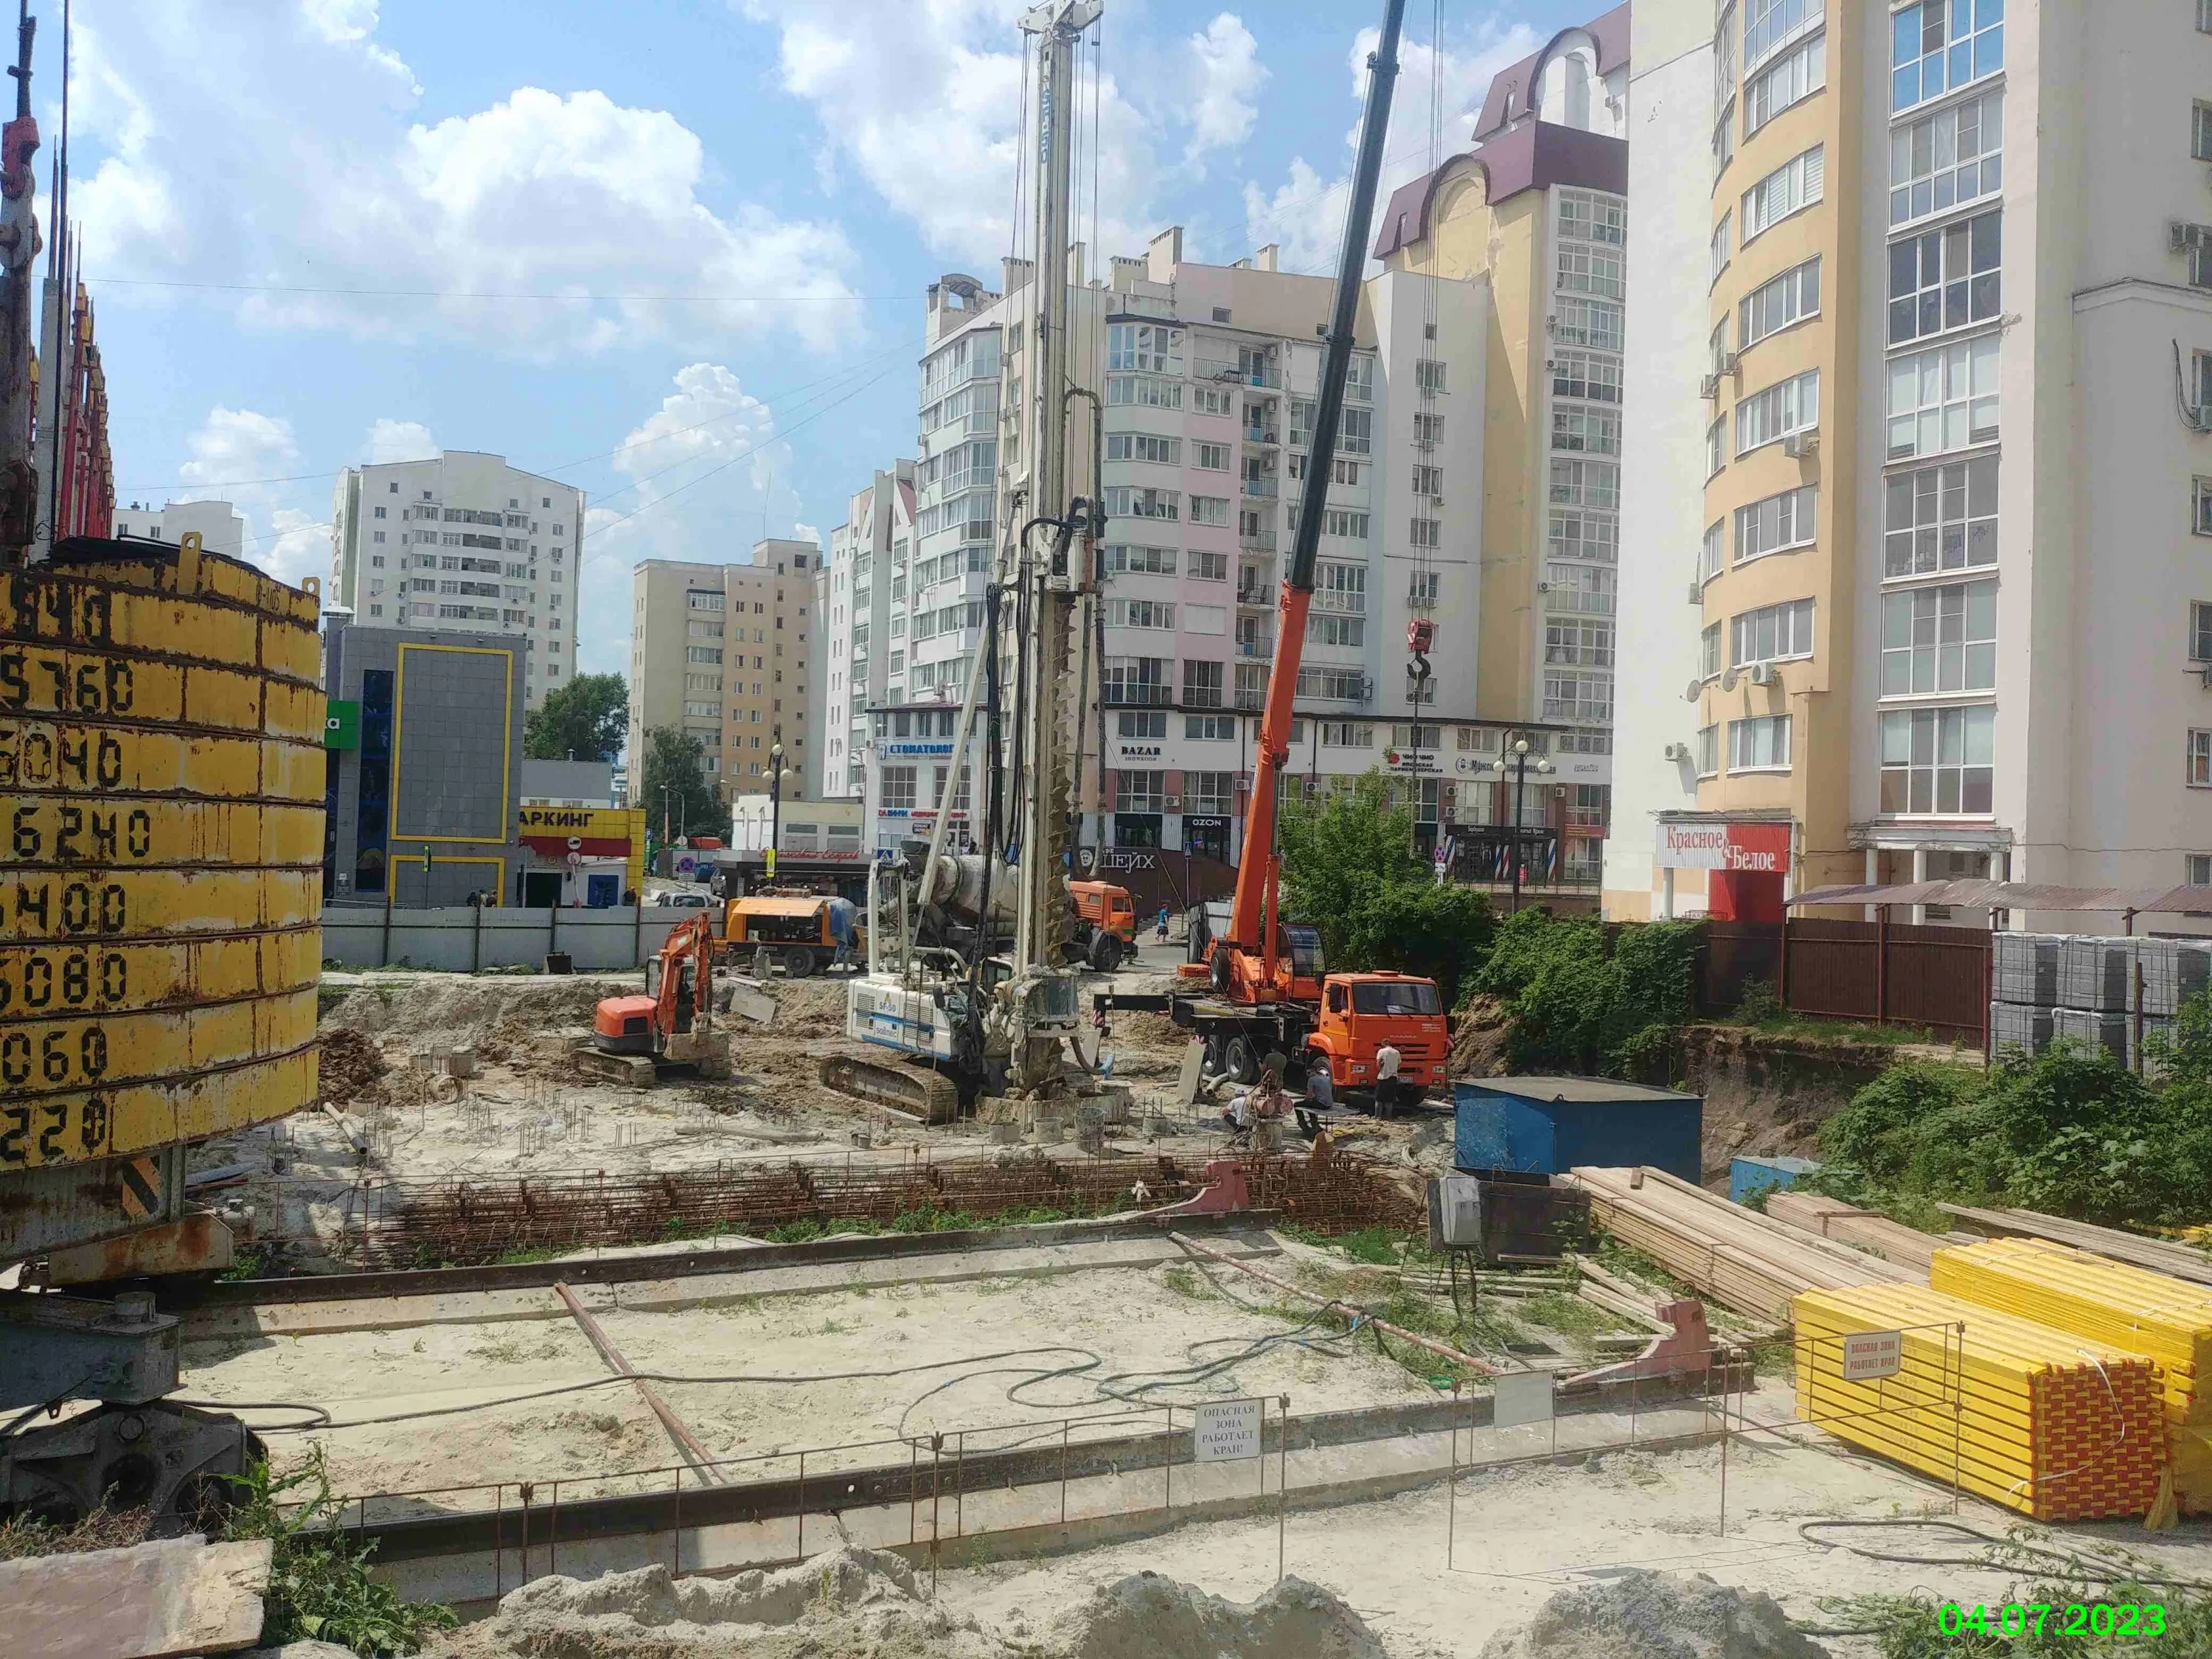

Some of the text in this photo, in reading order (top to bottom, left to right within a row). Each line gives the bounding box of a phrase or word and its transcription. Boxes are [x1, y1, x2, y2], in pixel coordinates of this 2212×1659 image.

[1, 654, 133, 714] 5760
[890, 743, 956, 754] СТОМАТОЛОГ
[1121, 746, 1161, 756] BAZAR
[519, 811, 594, 827] АРКИНГ
[1192, 818, 1222, 827] OZON
[13, 807, 150, 858] 6240
[1666, 826, 1723, 855] Красное
[1728, 845, 1775, 870] Белое
[0, 883, 125, 932] 400
[3, 1027, 107, 1083] 060
[1203, 1405, 1255, 1417] ОПАСНАЯ
[1216, 1419, 1242, 1429] ЗОНА
[1202, 1430, 1253, 1443] РАБОТАЕТ
[1214, 1444, 1242, 1455] КРАН!
